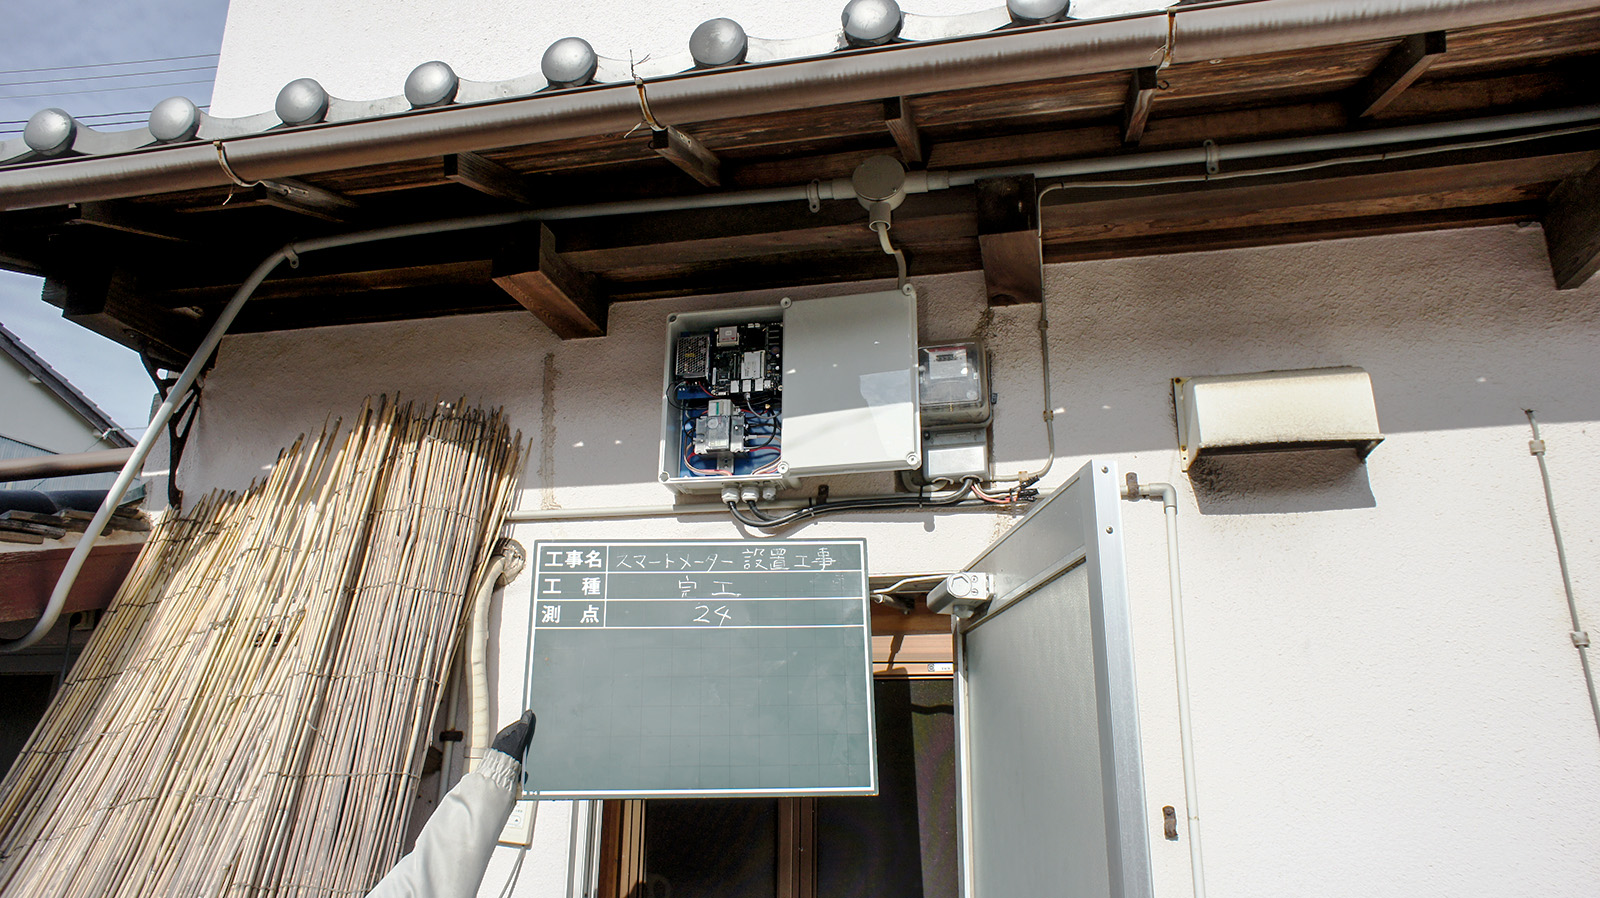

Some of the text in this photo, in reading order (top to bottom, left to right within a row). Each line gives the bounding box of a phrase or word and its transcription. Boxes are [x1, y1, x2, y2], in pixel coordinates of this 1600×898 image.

[544, 549, 602, 569] 工事名
[693, 605, 732, 627] 24
